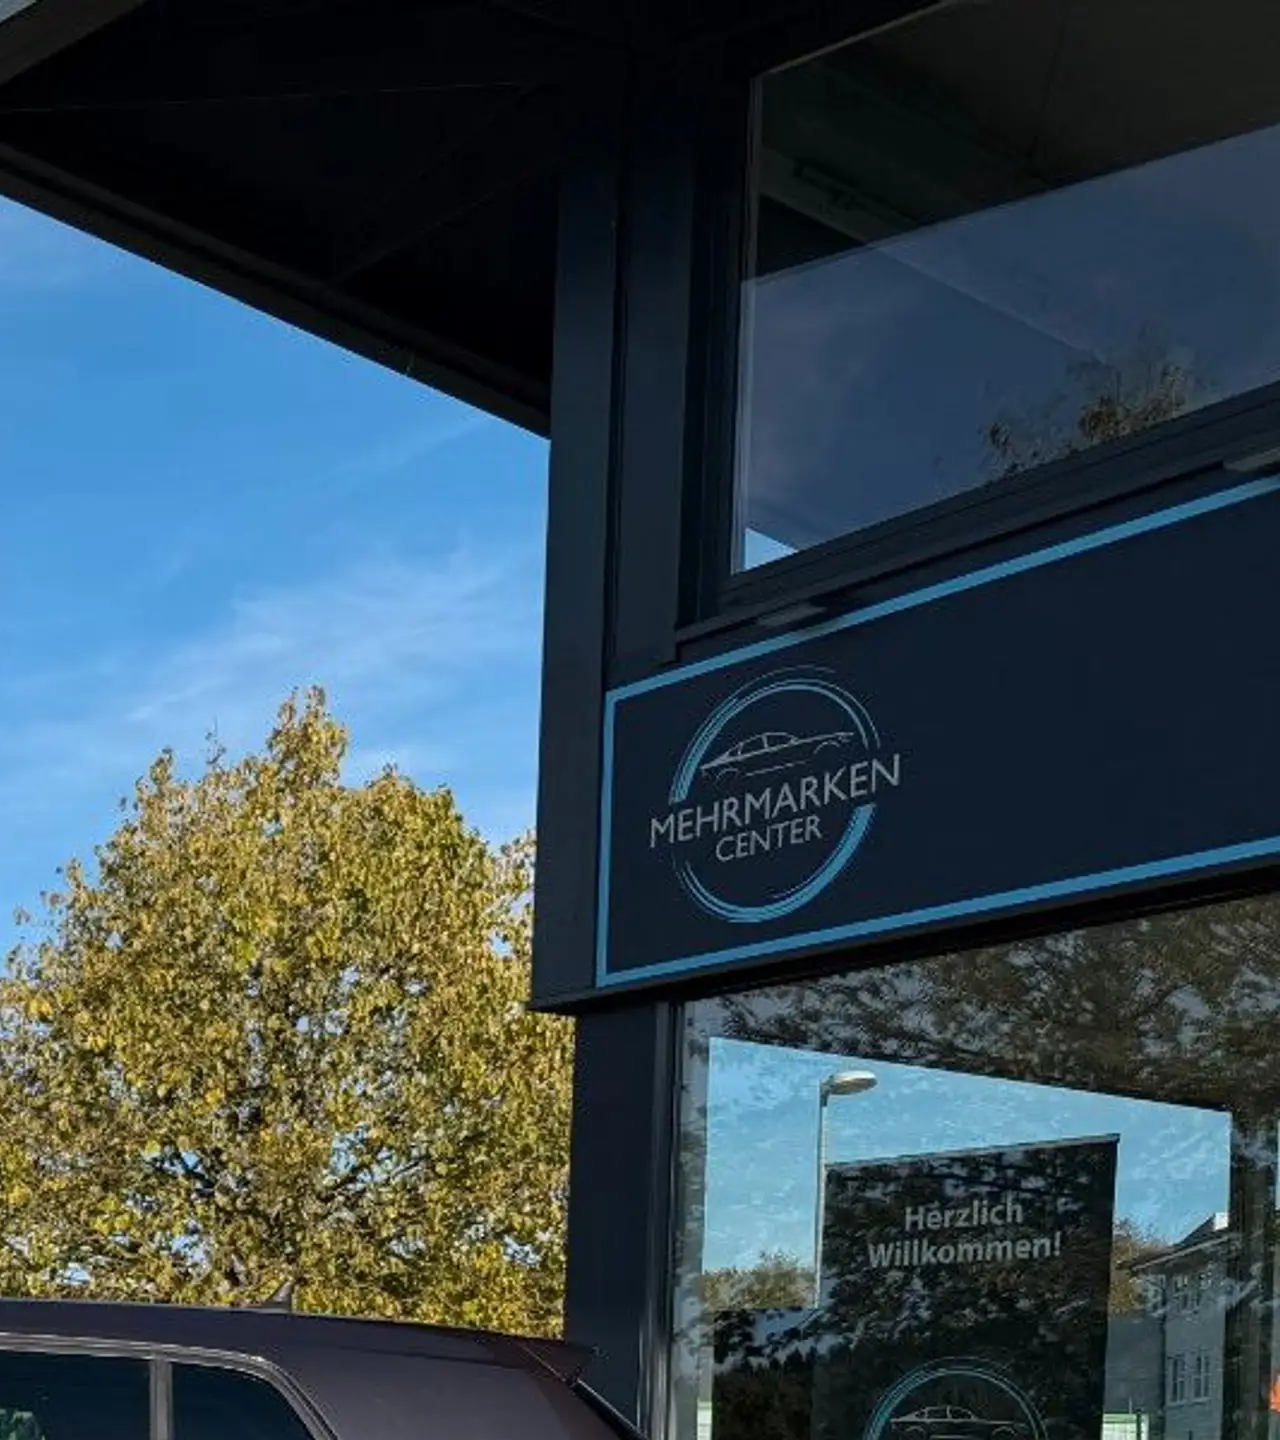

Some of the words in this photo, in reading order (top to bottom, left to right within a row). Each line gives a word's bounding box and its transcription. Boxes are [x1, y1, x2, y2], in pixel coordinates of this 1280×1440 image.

[649, 752, 901, 849] MEHRMARKEN
[715, 814, 823, 862] CENTER
[904, 1195, 1024, 1232] Herzlich
[867, 1230, 1062, 1268] Willkommen!
